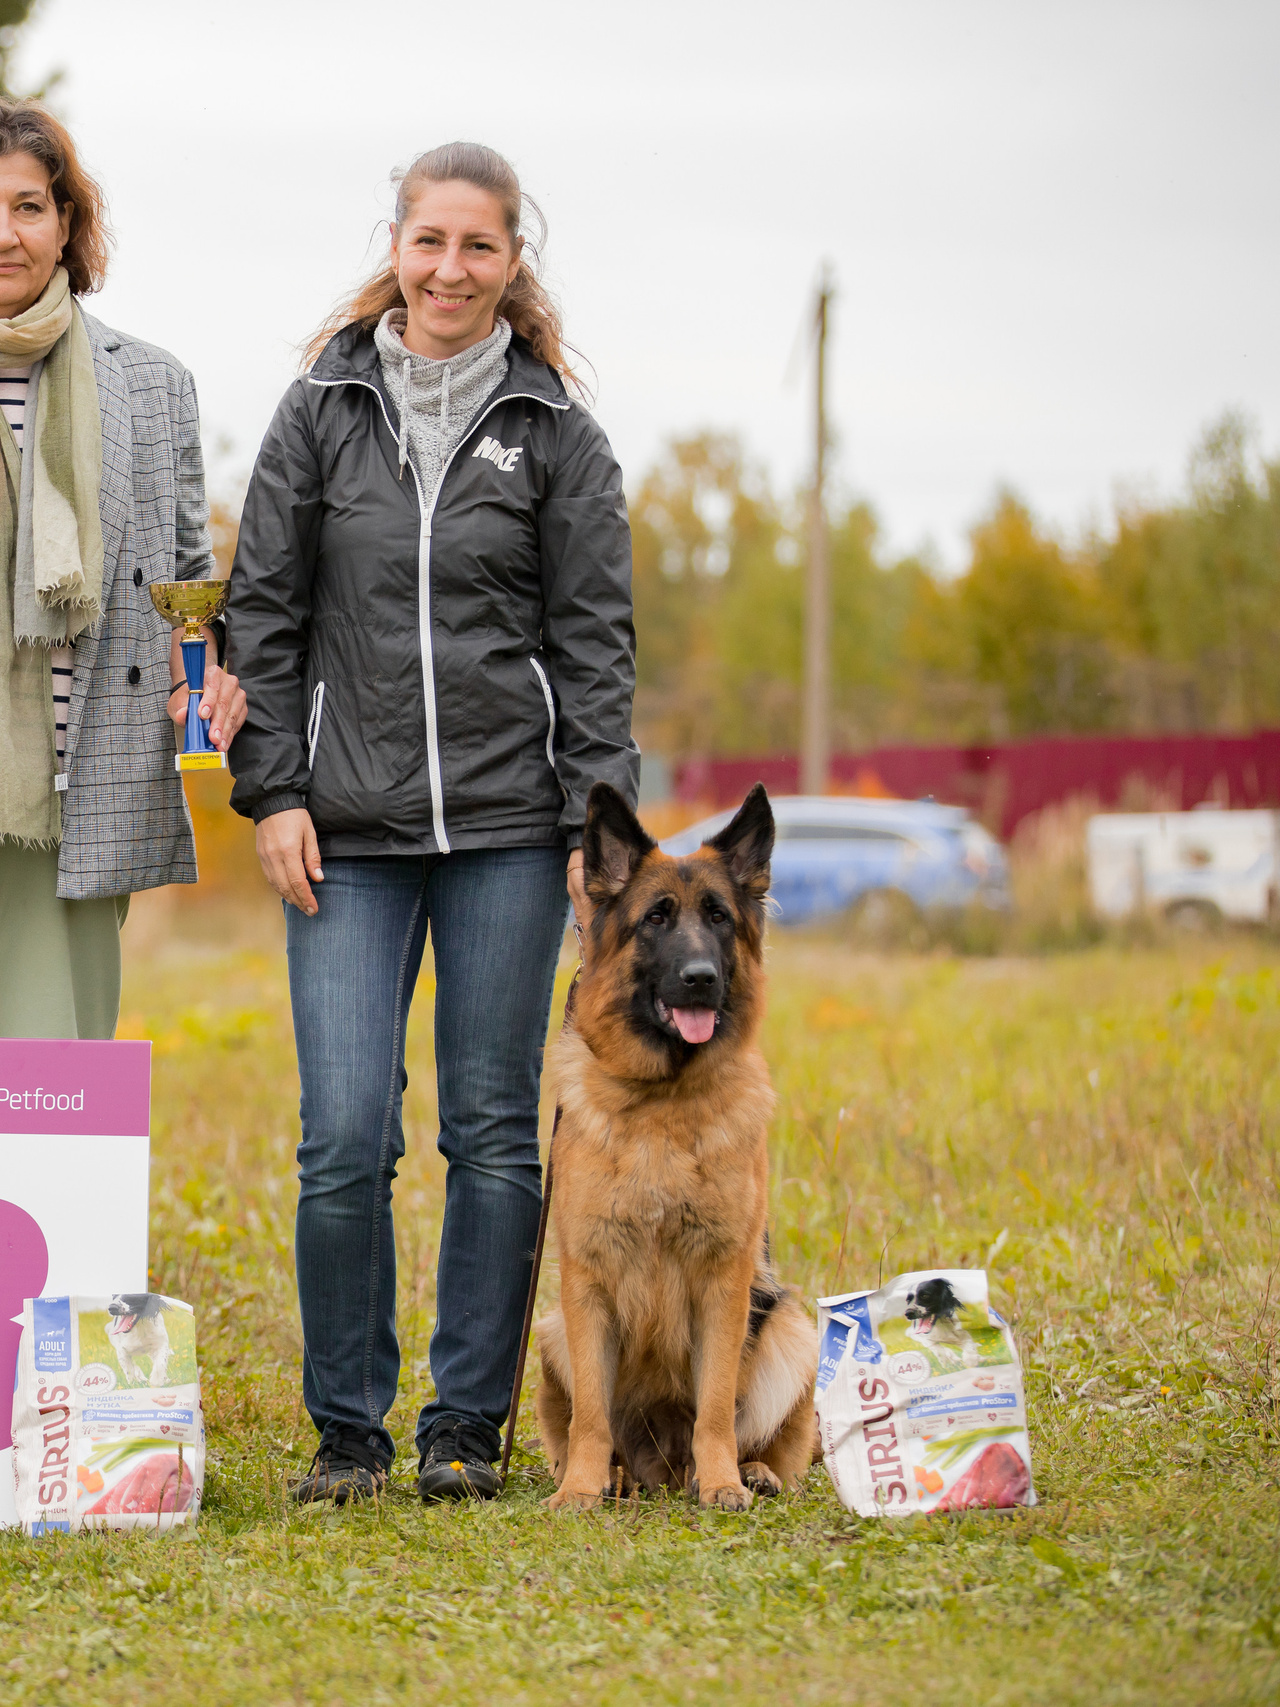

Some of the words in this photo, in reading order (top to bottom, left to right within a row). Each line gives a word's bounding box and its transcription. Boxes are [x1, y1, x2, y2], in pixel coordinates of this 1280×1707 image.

[472, 436, 523, 472] NIKE
[39, 1341, 66, 1352] ADULT
[898, 1363, 922, 1374] 44%
[83, 1376, 109, 1387] 44%
[908, 1384, 955, 1396] ИНДЕЙКА
[919, 1394, 944, 1404] УТКА
[157, 1412, 190, 1420] ProStor+
